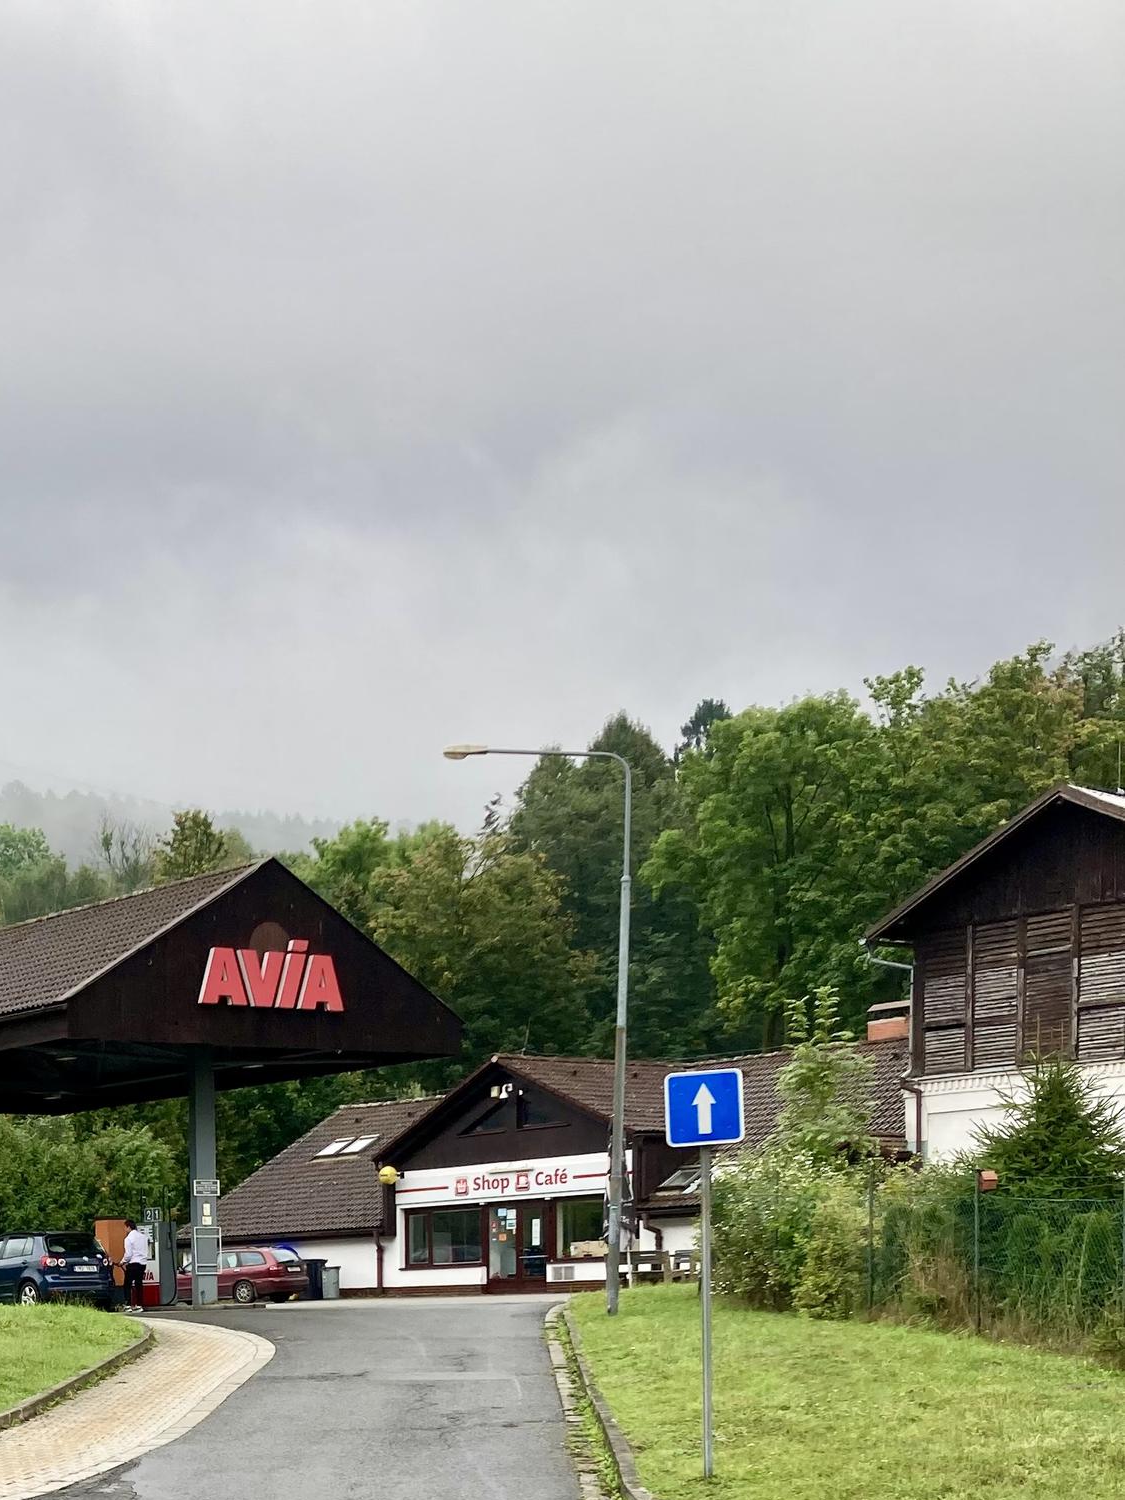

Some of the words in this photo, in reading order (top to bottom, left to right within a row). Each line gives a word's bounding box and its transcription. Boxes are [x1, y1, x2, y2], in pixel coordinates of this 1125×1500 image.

[197, 939, 345, 1012] AVIA
[473, 1175, 510, 1194] Shop
[535, 1168, 568, 1186] Café
[146, 1210, 153, 1220] 2
